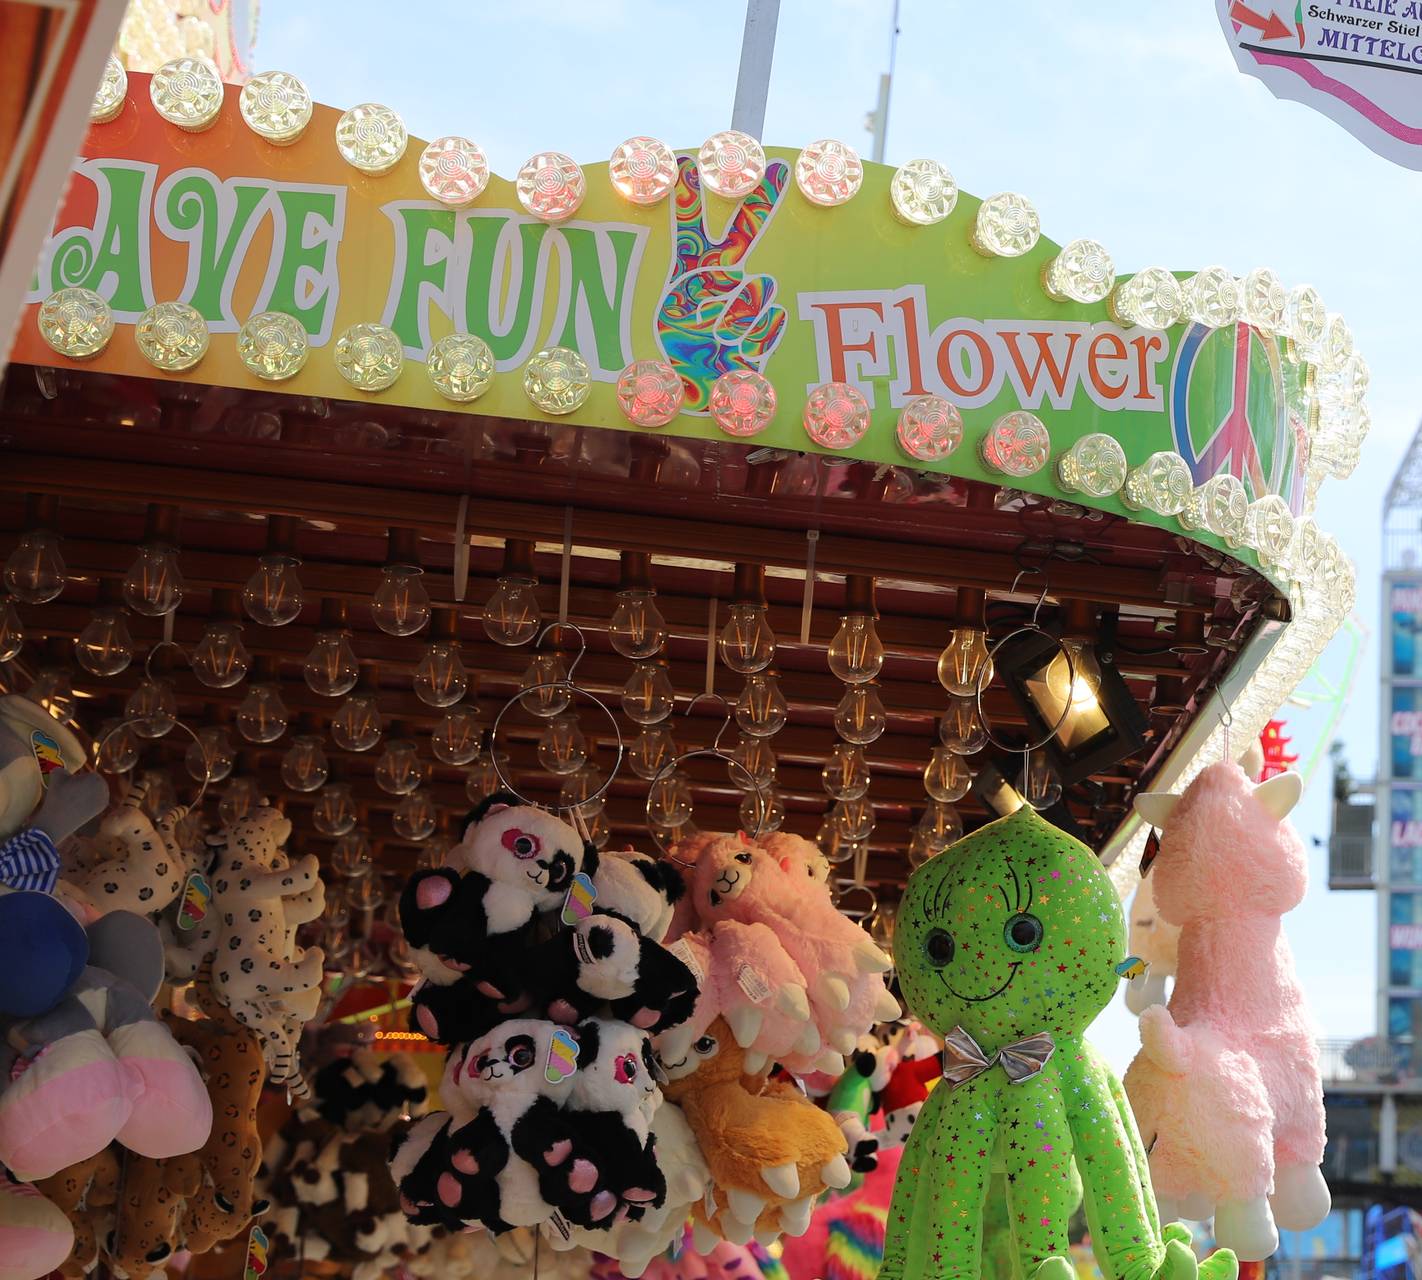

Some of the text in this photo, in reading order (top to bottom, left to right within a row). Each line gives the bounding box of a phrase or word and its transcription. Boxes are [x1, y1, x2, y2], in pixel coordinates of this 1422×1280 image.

[1308, 5, 1383, 31] Schwarzer
[1336, 0, 1397, 15] EIE
[31, 166, 1162, 401] AVE FUN Flower
